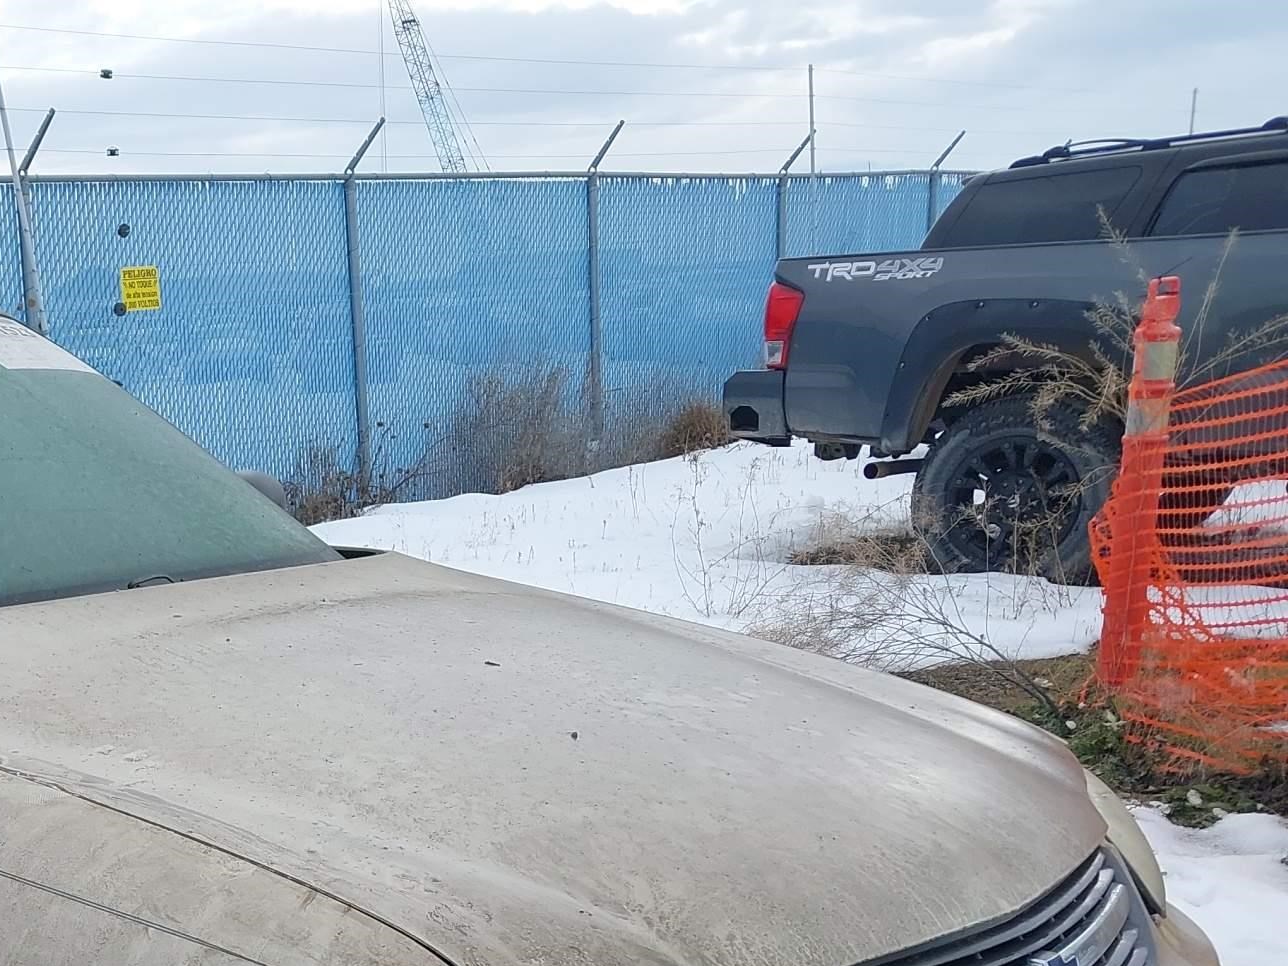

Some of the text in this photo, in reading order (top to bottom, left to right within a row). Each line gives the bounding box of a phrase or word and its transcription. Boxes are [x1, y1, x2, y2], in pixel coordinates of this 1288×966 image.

[122, 269, 157, 278] PELIGRO
[807, 261, 877, 282] TRD
[872, 270, 934, 281] SPORT
[137, 280, 152, 288] TOQUE
[138, 299, 159, 307] VOLTIOS
